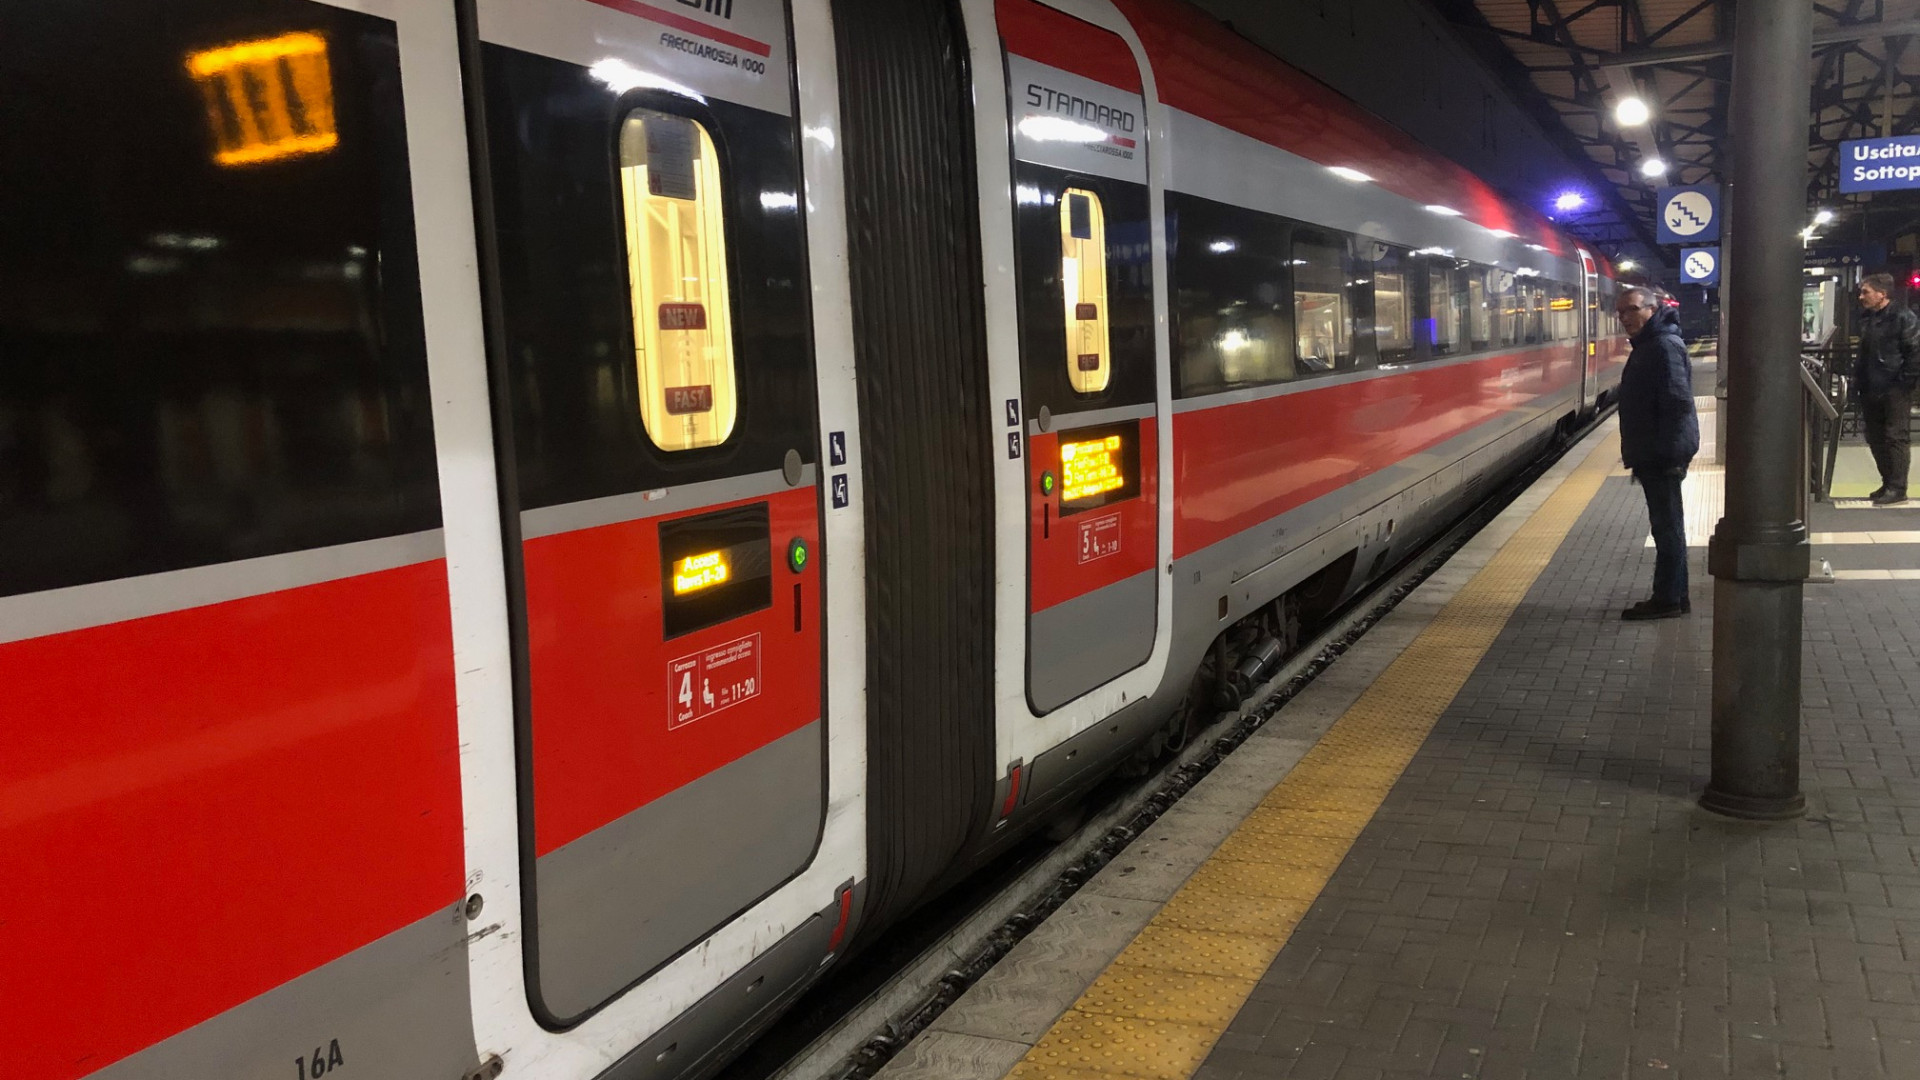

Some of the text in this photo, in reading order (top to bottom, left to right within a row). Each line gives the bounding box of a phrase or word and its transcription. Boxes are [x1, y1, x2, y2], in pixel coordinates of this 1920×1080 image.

[660, 33, 765, 75] FRECCIAROSSA 1000
[1026, 84, 1134, 132] STANDARD
[666, 308, 698, 327] NEW
[674, 390, 706, 410] FAST
[1083, 530, 1090, 554] 5
[678, 671, 693, 708] 4
[731, 677, 755, 700] 11-20
[295, 1038, 344, 1080] 16A
